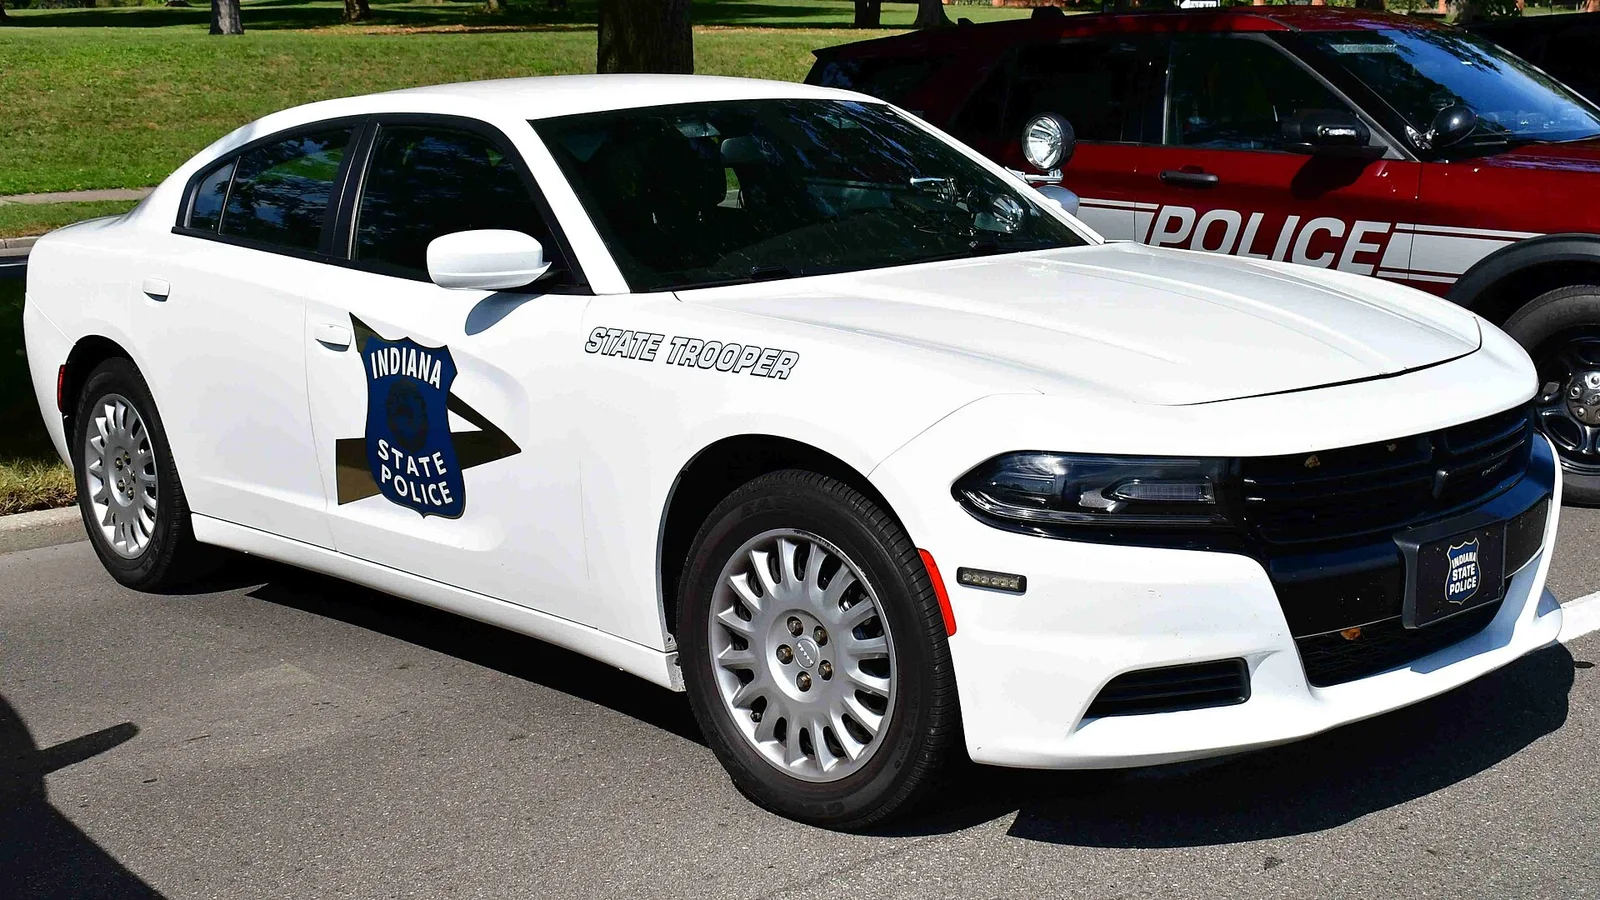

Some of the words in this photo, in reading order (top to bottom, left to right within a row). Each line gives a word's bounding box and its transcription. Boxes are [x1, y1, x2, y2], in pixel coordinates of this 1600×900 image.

[1148, 205, 1391, 277] POLICE
[371, 347, 442, 389] INDIANA
[585, 326, 665, 362] STATE
[666, 336, 800, 380] TROOPER
[378, 438, 448, 478] STATE
[381, 464, 453, 506] POLICE
[1451, 551, 1477, 569] INDIANA
[1452, 562, 1476, 582] STATE
[1449, 575, 1477, 596] POLICE
